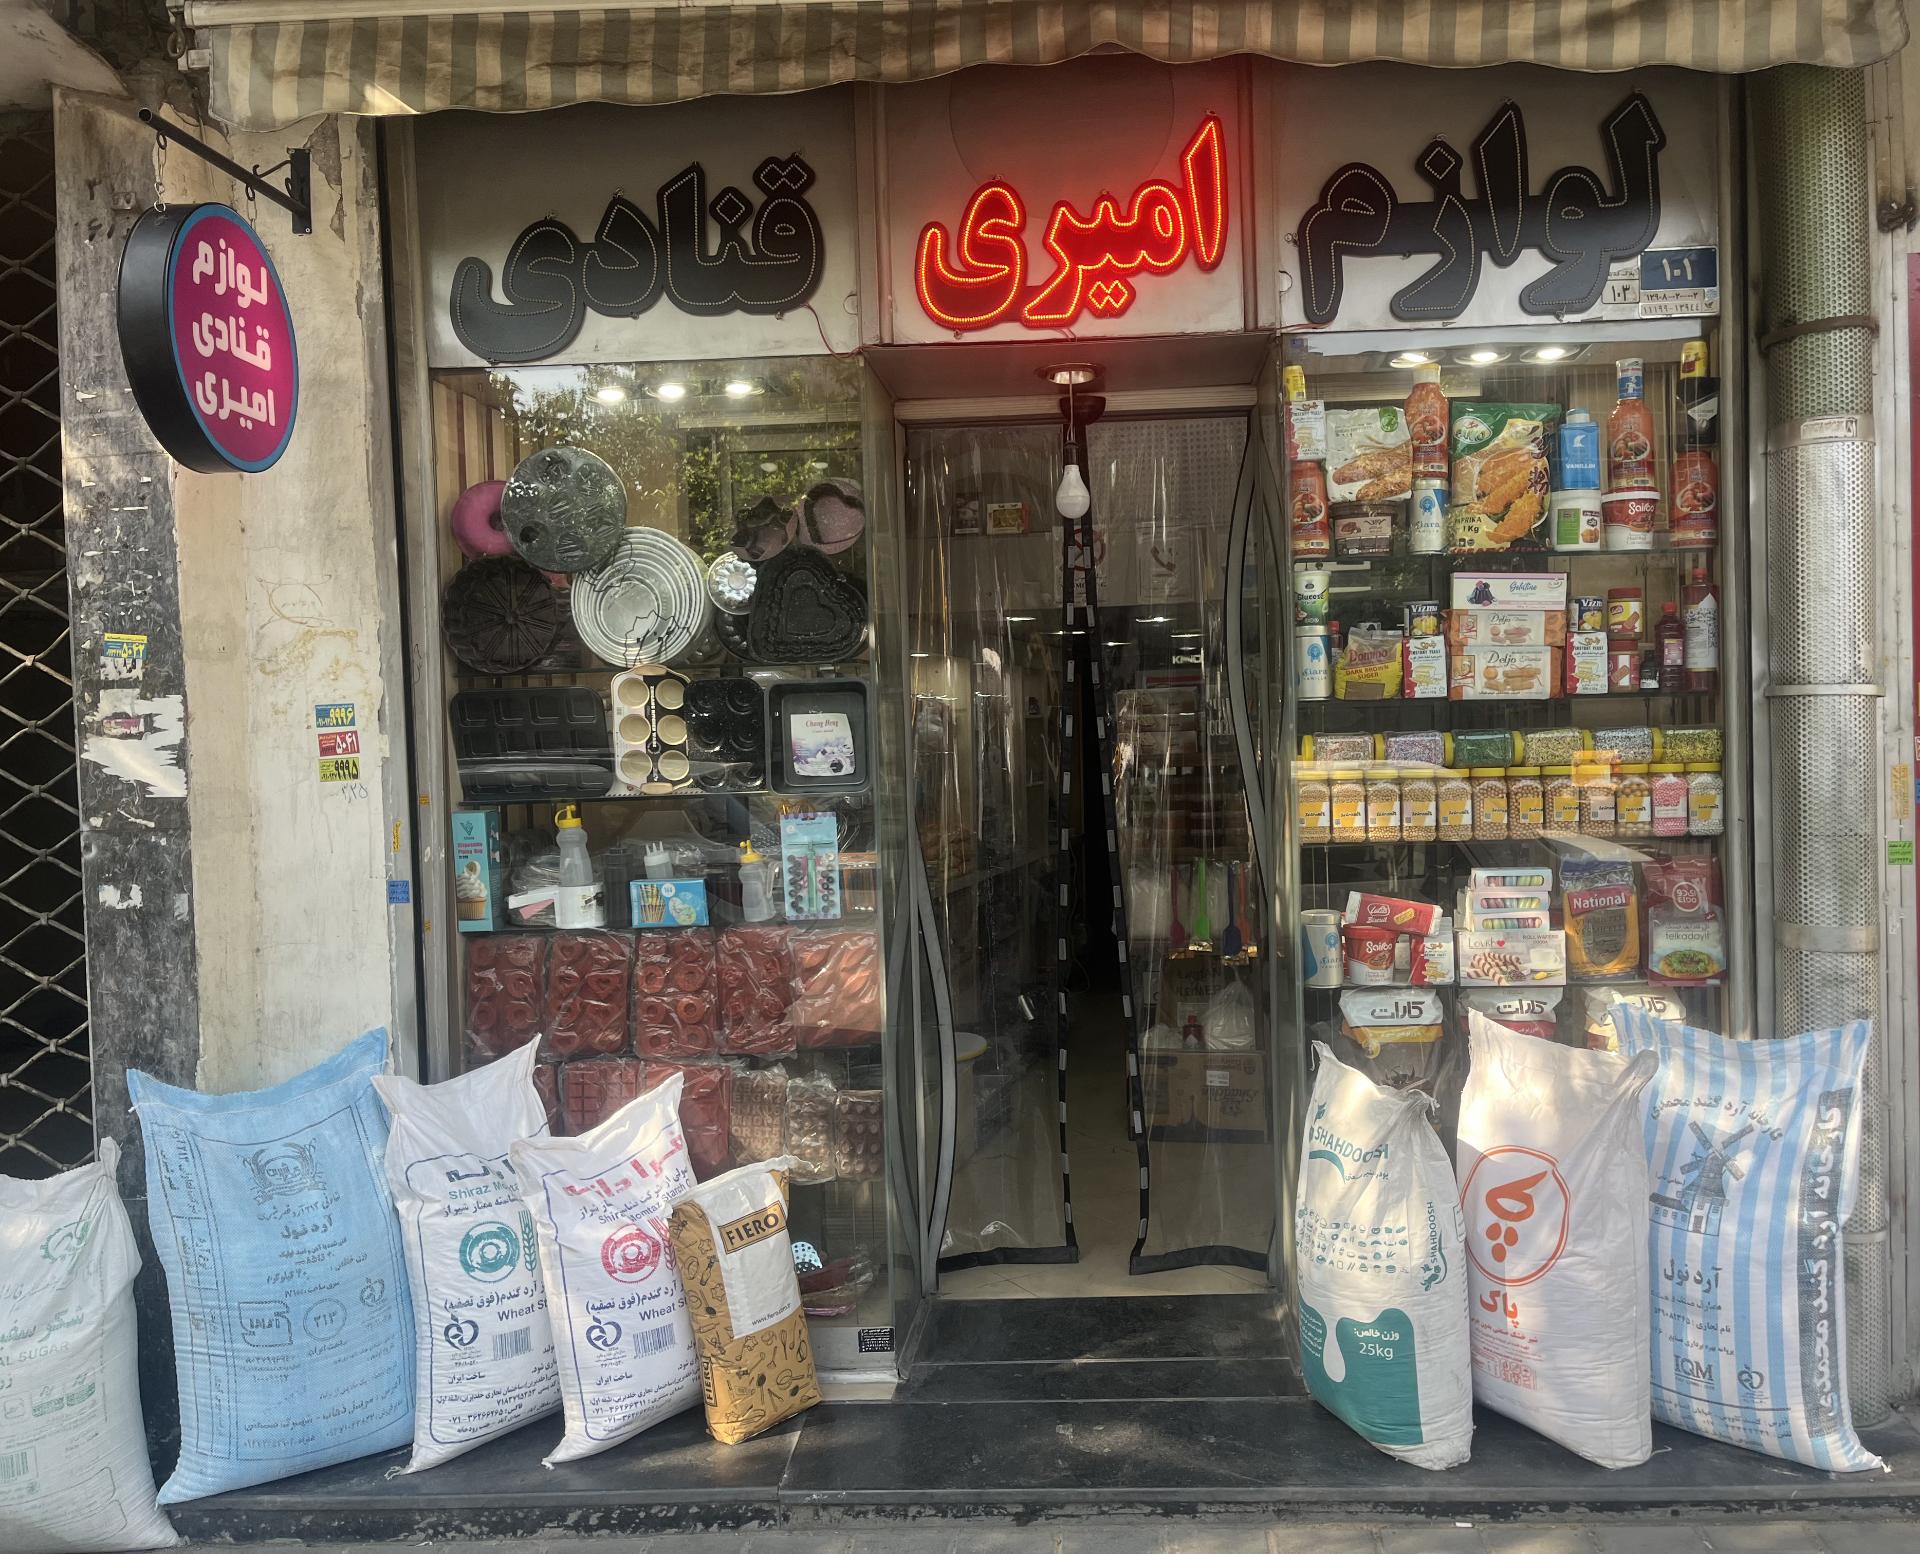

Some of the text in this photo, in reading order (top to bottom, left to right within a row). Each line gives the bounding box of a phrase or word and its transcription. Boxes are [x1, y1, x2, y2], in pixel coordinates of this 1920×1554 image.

[449, 92, 1667, 364] لوازم امیری قنادی
[192, 238, 269, 309] لوازم
[1612, 284, 1631, 302] ۱۰۳
[192, 312, 272, 371] قنادی
[195, 371, 276, 430] امیری
[335, 759, 358, 780] ۹۹۹۵
[1572, 892, 1626, 910] National
[1370, 1000, 1425, 1019] کارات
[1496, 998, 1548, 1015] کارات
[1724, 1100, 1751, 1117] آرد
[448, 1184, 491, 1201] Shiraz
[661, 1185, 686, 1202] Starch
[310, 1214, 333, 1234] آرد
[726, 1212, 780, 1247] FIERO
[1426, 1201, 1439, 1264] SHAHDOOSH
[1803, 1207, 1838, 1250] آرد
[1663, 1258, 1723, 1294] آرد نول
[1804, 1257, 1834, 1315] گنبد
[499, 1287, 521, 1304] گندم
[524, 1283, 538, 1299] آرد
[585, 1281, 678, 1315] آرد گندم (فوق تصفیه)
[497, 1303, 535, 1323] Wheat
[639, 1305, 676, 1323] Wheat
[1479, 1290, 1520, 1329] پاک
[313, 1311, 337, 1329] ۳۱۳
[1381, 1331, 1400, 1341] وزن
[19, 1340, 69, 1362] SUGAR
[1359, 1342, 1394, 1361] 25kg
[1673, 1354, 1714, 1381] IQM
[1813, 1318, 1838, 1417] محمدی
[447, 1371, 486, 1386] ساخت ایران
[595, 1371, 633, 1386] ساخت ایران
